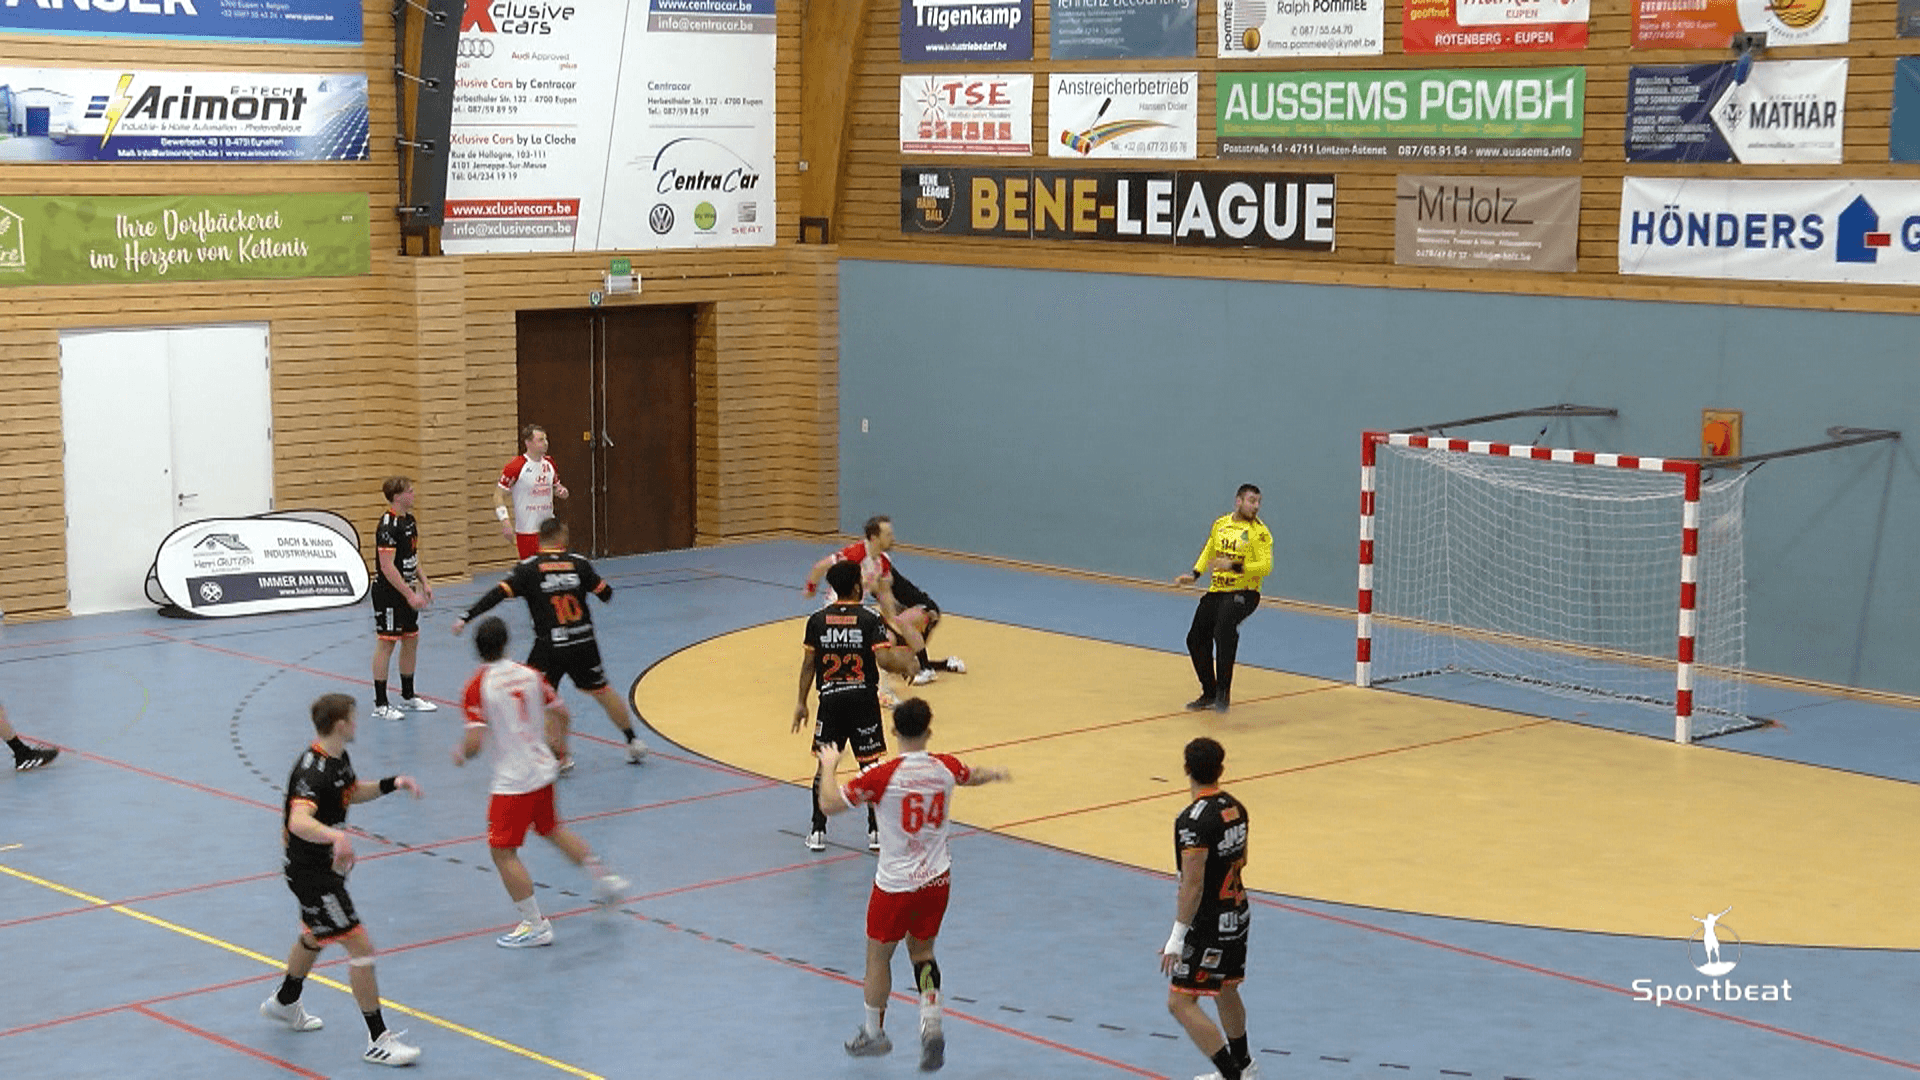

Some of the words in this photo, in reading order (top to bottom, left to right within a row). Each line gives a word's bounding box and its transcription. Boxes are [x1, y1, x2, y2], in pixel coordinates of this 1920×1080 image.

[658, 0, 753, 12] www.centracar.be
[1277, 0, 1310, 16] Ralph
[913, 0, 1022, 32] Tilgenkamp
[1505, 9, 1539, 19] EUPEN
[501, 19, 552, 35] cars
[657, 16, 754, 31] info@centracar.be
[1434, 33, 1501, 46] ROTENBERG
[1514, 31, 1554, 44] EUPEN
[925, 41, 1008, 52] www.industriebedarf.be
[511, 51, 530, 60] Audi
[531, 51, 570, 62] Approved
[491, 78, 513, 88] Cars
[516, 79, 527, 90] by
[530, 79, 577, 89] Centracar
[647, 81, 691, 91] Centracar
[1057, 78, 1189, 96] Anstreicherbetrieb
[534, 95, 553, 103] 4700
[555, 95, 578, 105] Eupen
[942, 82, 1011, 106] TSE
[1224, 80, 1408, 121] AUSSEMS
[1420, 78, 1574, 121] PGMBH
[125, 85, 307, 121] Arimont
[743, 98, 763, 107] Eupen
[1139, 102, 1166, 111] Hansen
[1749, 100, 1837, 130] MATHAR
[451, 133, 489, 144] Xclusive
[492, 133, 514, 144] Cars
[517, 134, 528, 146] by
[531, 135, 542, 144] La
[544, 134, 577, 144] Cloche
[1271, 144, 1283, 153] 14
[1291, 144, 1314, 154] 4711
[1475, 145, 1573, 157] www.aussems.info
[656, 168, 760, 195] CentraCar
[919, 173, 938, 186] BENE
[922, 186, 950, 199] LEAGUE
[452, 202, 572, 216] www.xclusivecars.be
[926, 209, 943, 221] BALL
[971, 177, 1334, 242] BENE-LEAGUE
[115, 213, 157, 239] Ihre
[163, 209, 282, 242] Dorfbäckerei
[453, 221, 572, 236] info@xclusivecars.be
[1630, 204, 1825, 250] HÖNDERS
[89, 249, 118, 269] im
[124, 239, 192, 275] Herzen
[196, 245, 233, 263] von
[238, 234, 309, 264] Kettenis
[277, 537, 300, 548] DACH
[302, 537, 310, 547] &
[310, 538, 334, 548] WAND
[264, 549, 337, 559] INDUSTRIEHALLEN
[258, 576, 296, 588] IMMER
[298, 575, 315, 587] AM
[316, 575, 345, 586] BALL!
[550, 593, 582, 624] 10
[820, 627, 863, 643] JMS
[822, 653, 865, 683] 23
[511, 690, 530, 722] 1
[901, 791, 945, 834] 64
